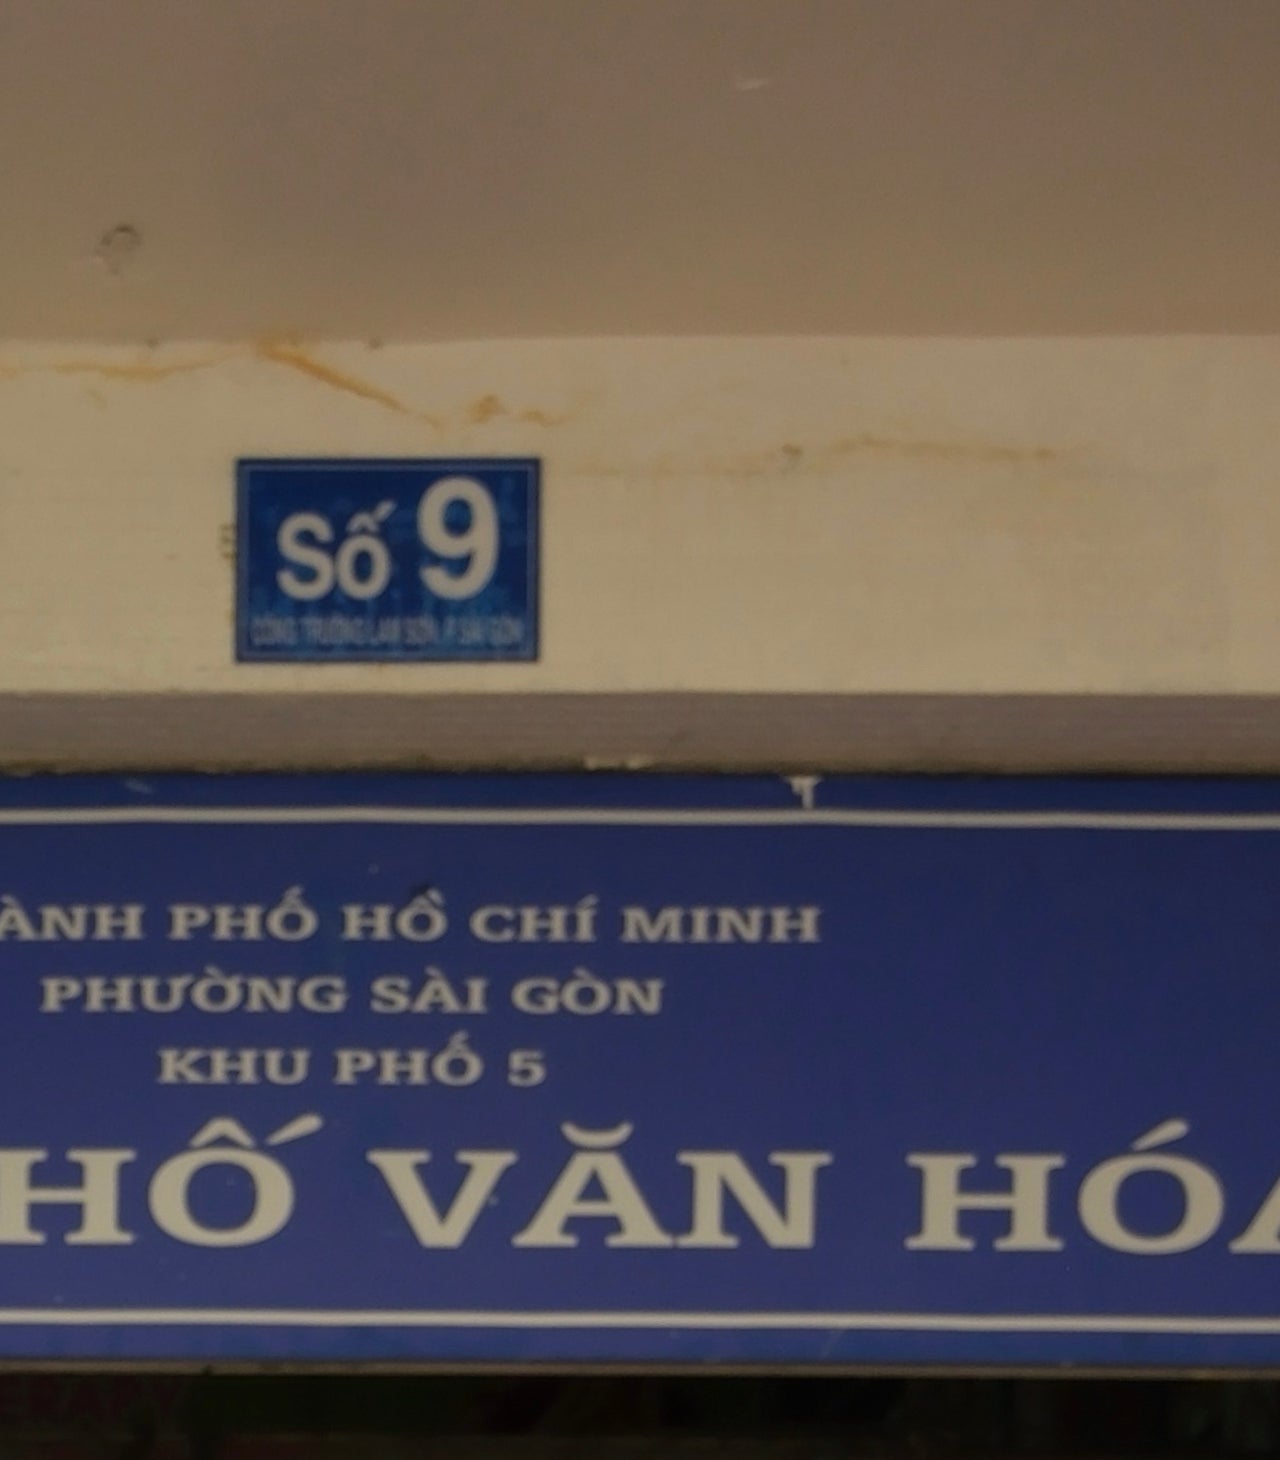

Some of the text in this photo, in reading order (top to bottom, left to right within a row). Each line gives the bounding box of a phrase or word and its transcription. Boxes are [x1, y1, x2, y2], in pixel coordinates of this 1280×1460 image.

[276, 476, 499, 600] Số 9
[167, 885, 318, 941] PHỐ
[341, 887, 448, 942] HỒ
[469, 893, 598, 943] CHÍ
[620, 905, 822, 943] MINH
[40, 966, 665, 1015] PHƯỜNG SÀI GÒN
[157, 1031, 546, 1087] KHU PHỐ 5
[366, 1121, 833, 1249] VĂN
